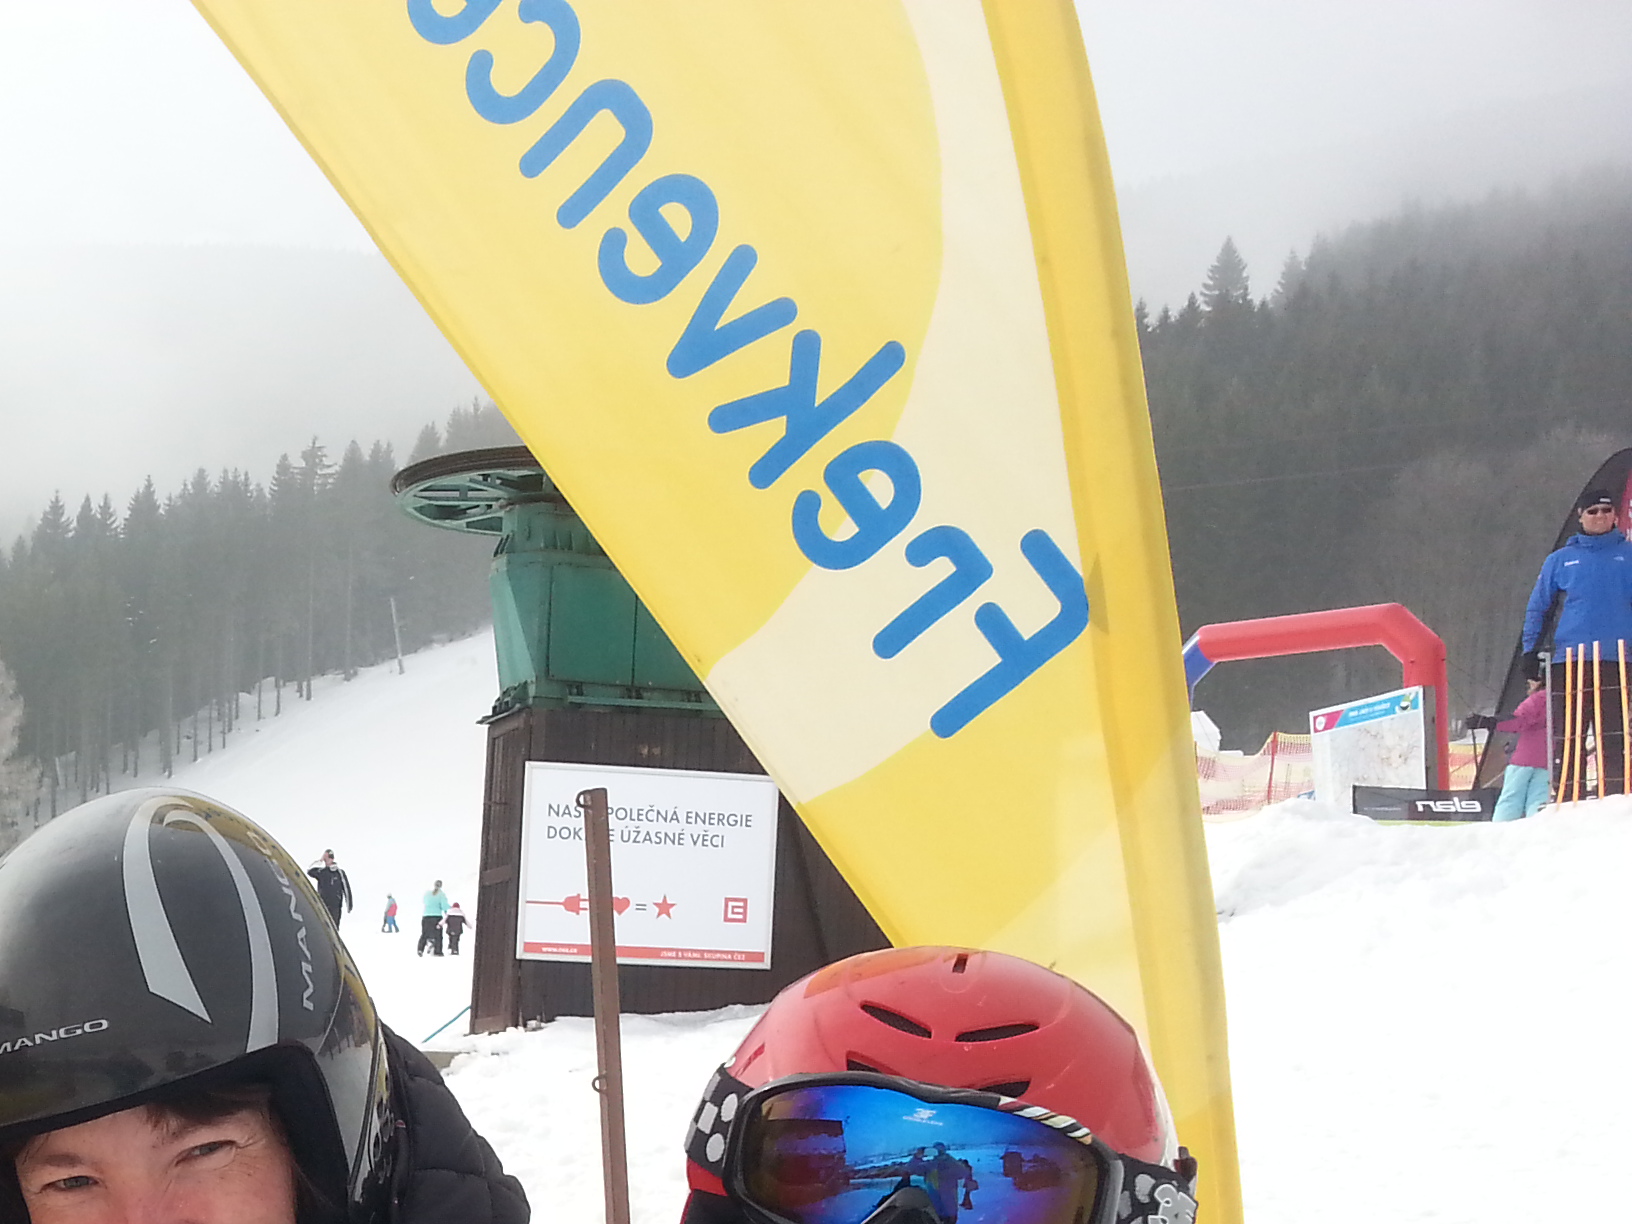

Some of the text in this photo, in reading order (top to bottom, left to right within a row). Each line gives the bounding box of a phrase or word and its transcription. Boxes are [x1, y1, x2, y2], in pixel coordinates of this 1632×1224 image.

[607, 804, 681, 825] POLEČNÁ
[685, 810, 753, 828] ENERGIE
[546, 825, 725, 848] DOKE ÚŽASNÉ VĚCI
